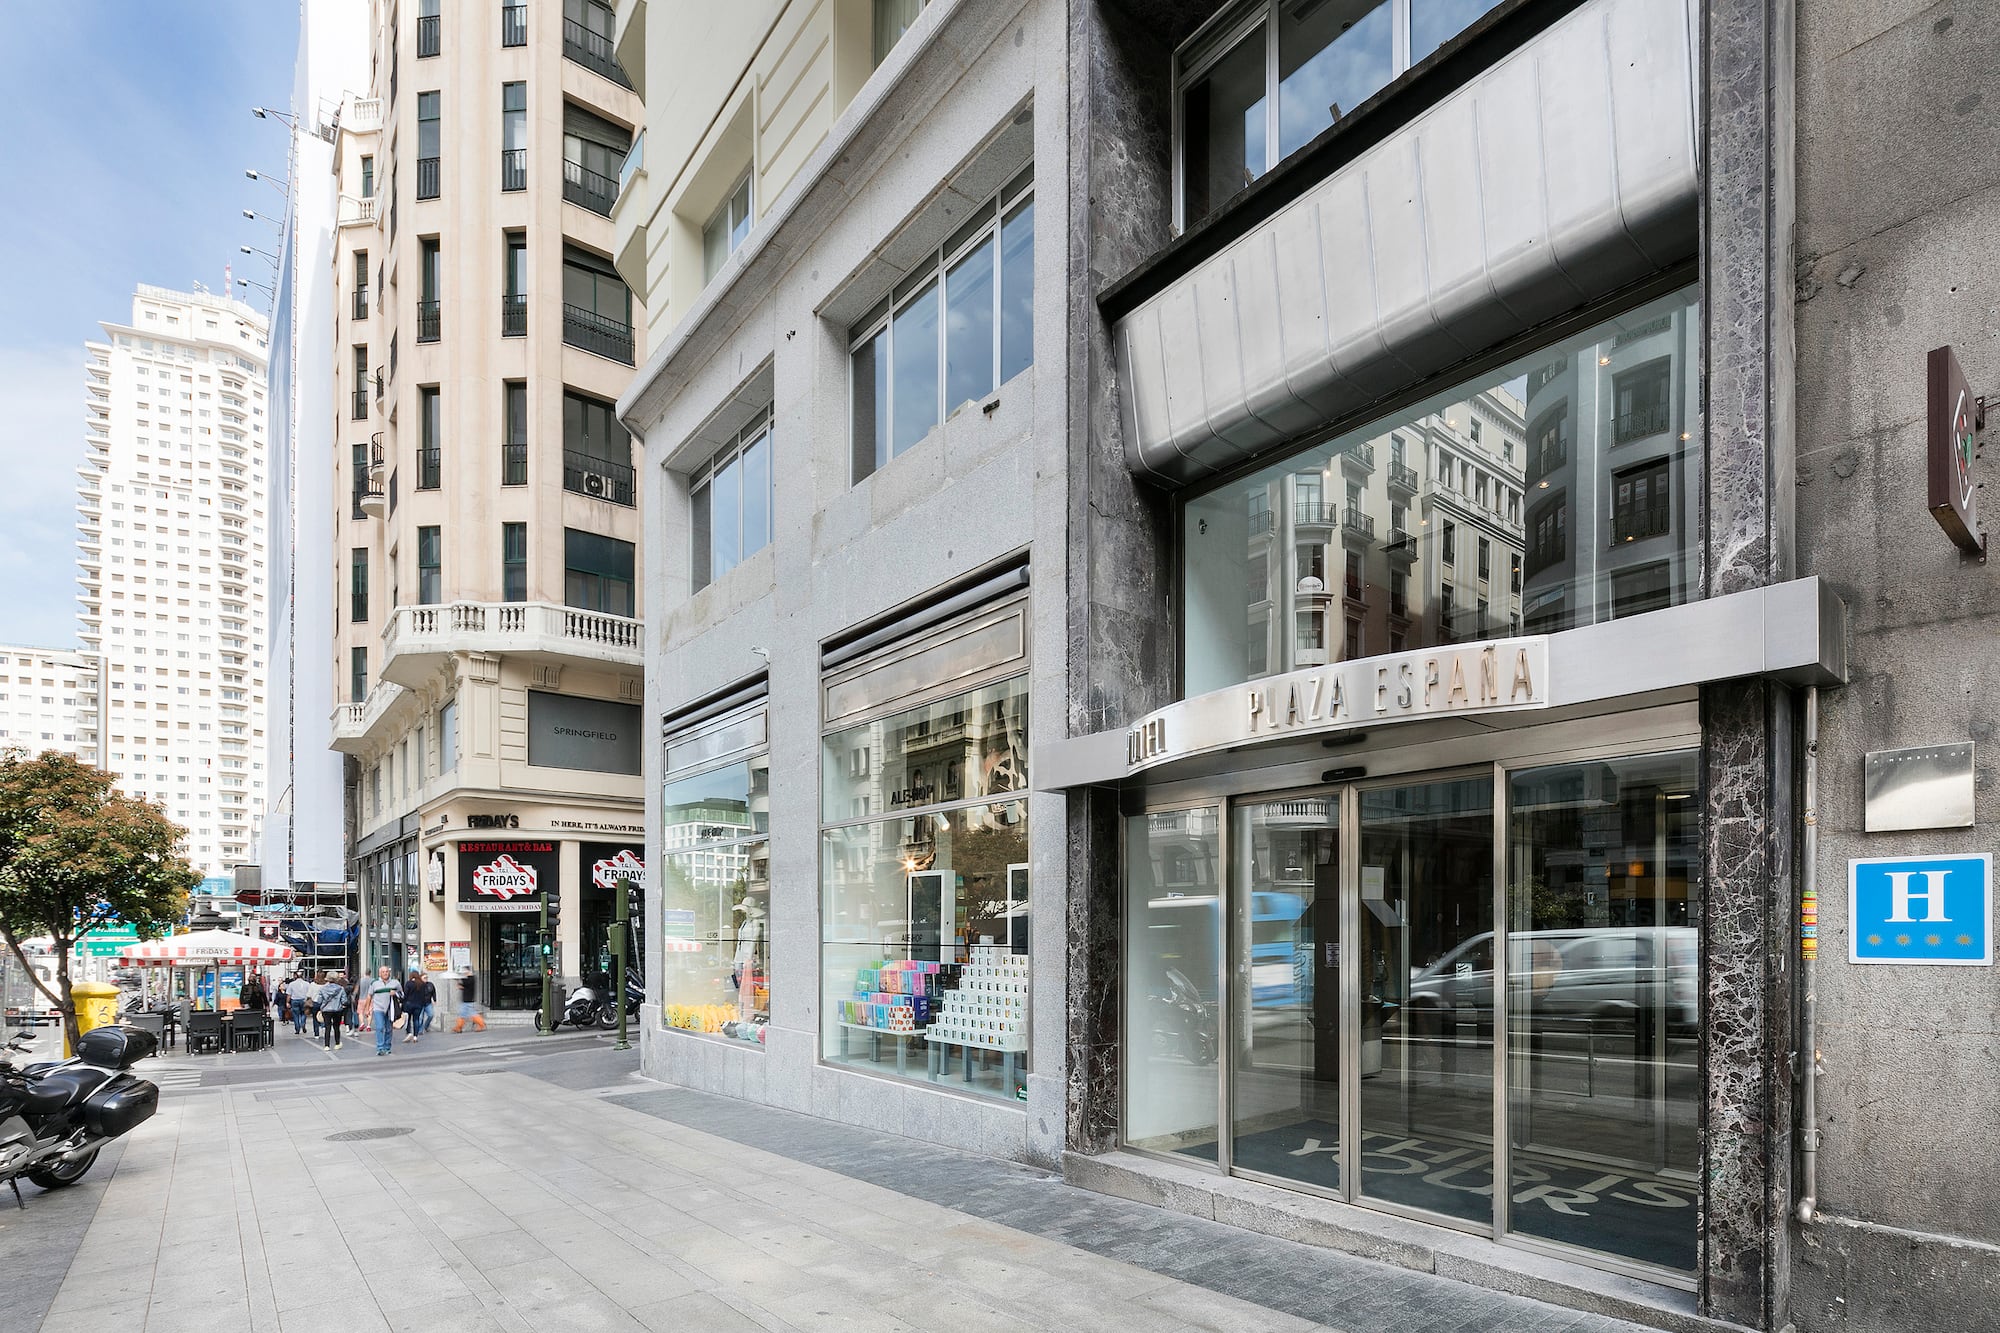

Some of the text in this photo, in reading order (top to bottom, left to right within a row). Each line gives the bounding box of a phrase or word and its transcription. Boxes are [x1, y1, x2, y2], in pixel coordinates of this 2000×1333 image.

[1248, 643, 1533, 732] PLAZA ESPAÑA
[554, 726, 617, 741] SPRINGFIELD
[600, 824, 627, 832] ALWAYS
[1884, 870, 1953, 922] H
[1288, 1138, 1599, 1217] YOUR
